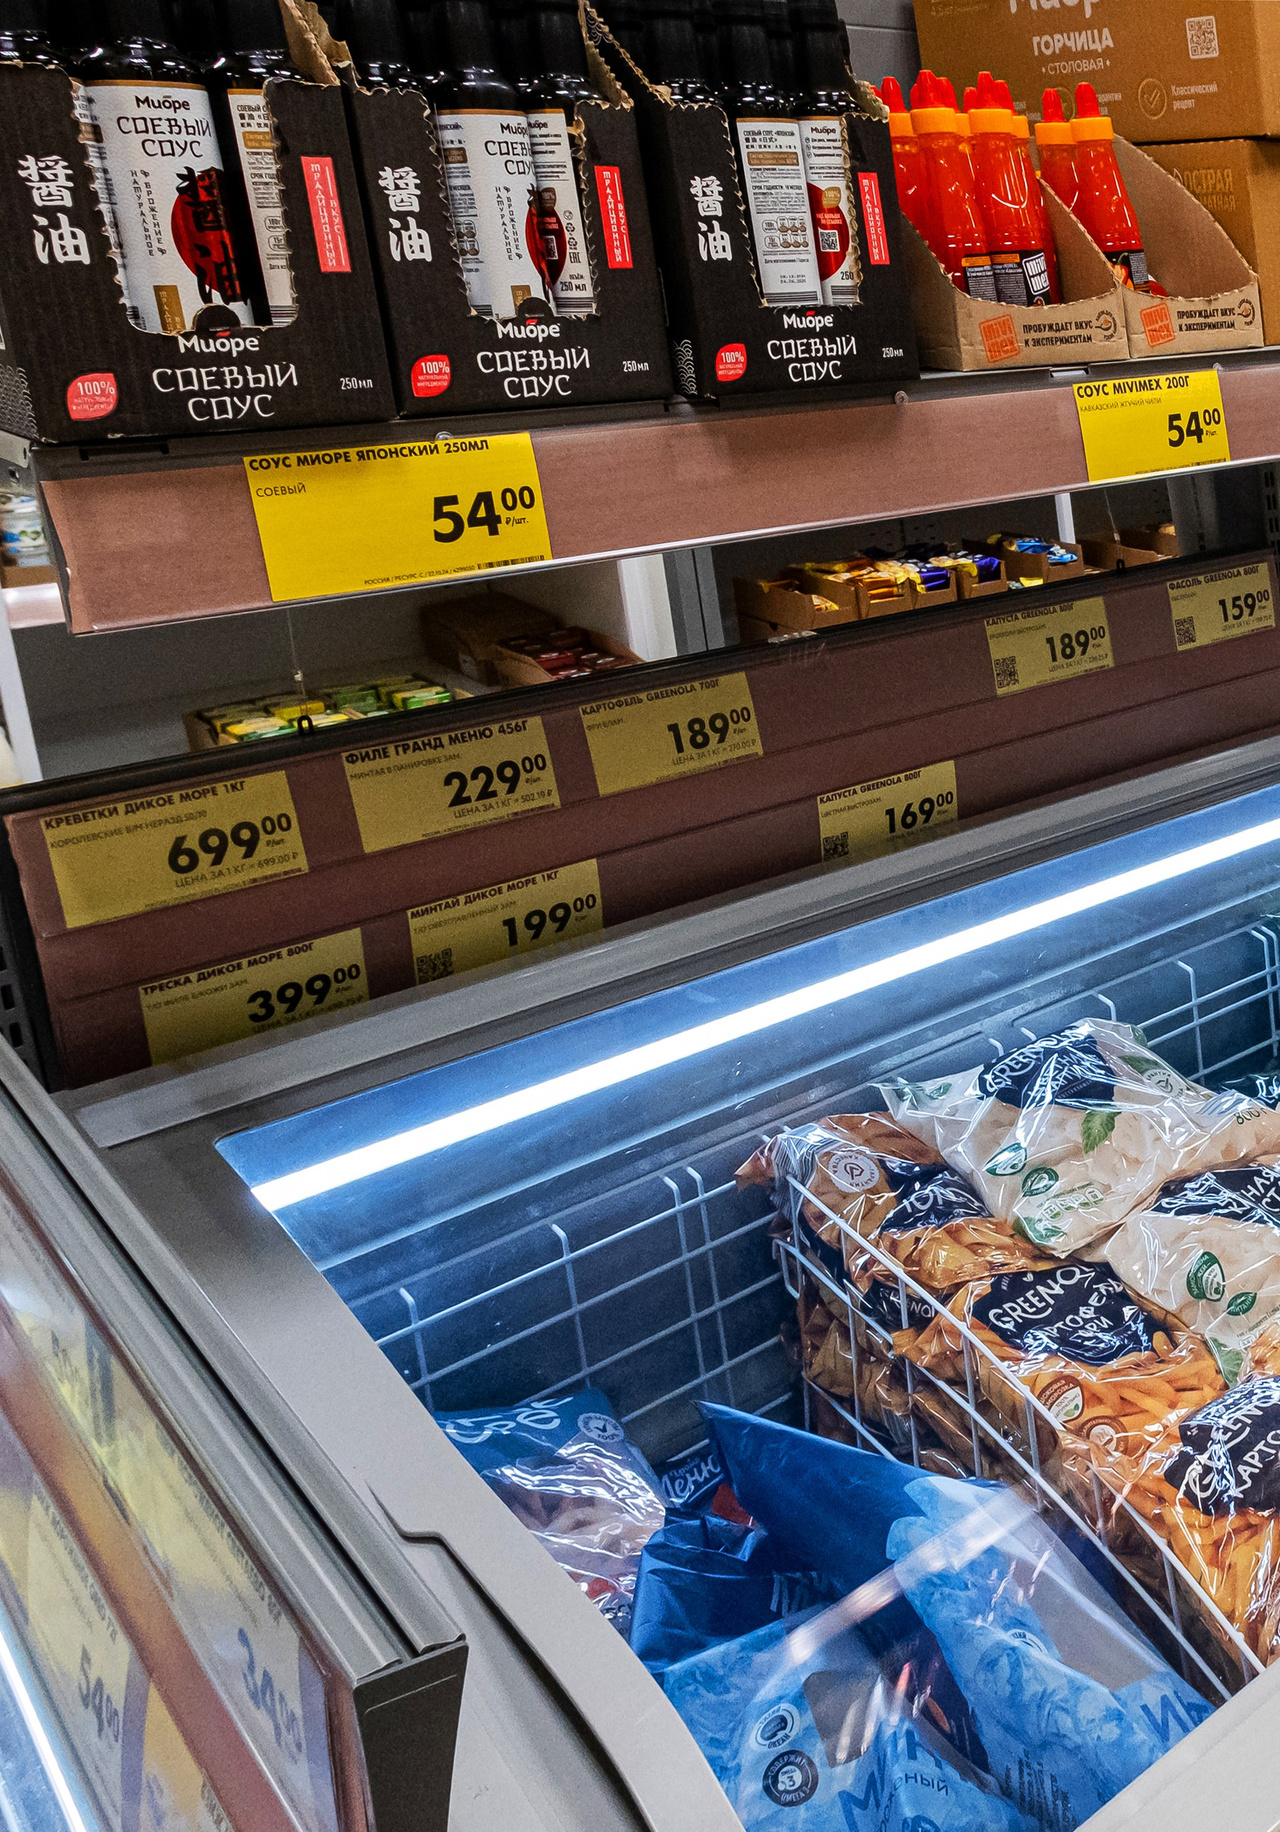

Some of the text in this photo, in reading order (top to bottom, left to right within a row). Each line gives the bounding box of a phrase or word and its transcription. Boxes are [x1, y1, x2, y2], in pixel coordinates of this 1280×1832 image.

[1033, 28, 1114, 56] ГОРЧИЦА
[1047, 58, 1105, 75] СТОЛОВАЯ
[1171, 82, 1217, 95] Классический
[1173, 99, 1195, 111] рецепт
[116, 116, 212, 138] СОЕВЫЙ
[141, 138, 203, 158] СОУС
[1183, 169, 1233, 191] ОСТРАЯ
[130, 169, 155, 257] НАТУРАЛЬНОЕ
[144, 182, 163, 245] БРОЖЕНИЕ
[310, 163, 337, 267] ТРАДИЦИОННЫЙ
[329, 199, 342, 234] ВКУС
[602, 171, 623, 263] ТРАДИЦИОННЫЙ
[617, 202, 627, 234] ВКУС
[861, 178, 880, 261] ТРАДИЦИОННЫЙ
[874, 206, 883, 235] ВКУС
[1176, 307, 1236, 320] ПРОБУЖДАЕТ ВКУС
[1178, 319, 1235, 331] К ЭКСПЕРИМЕНТАМ
[1023, 319, 1093, 335] ПРОБУЖДАЕТ ВКУС
[767, 334, 857, 360] СОЕВЫЙ
[1024, 333, 1092, 347] К ЭКСПЕРИМЕНТАМ
[420, 361, 450, 374] 100%
[477, 346, 591, 371] СОЕВЫЙ
[720, 350, 745, 364] 100%
[152, 362, 299, 392] СОЕВЫЙ
[788, 360, 843, 383] СОУС
[76, 381, 116, 396] 100%
[503, 375, 572, 398] СОУС
[1077, 375, 1189, 399] СОУС MIVIMEX 200Г
[187, 394, 275, 421] СОУС
[1080, 397, 1162, 413] КАВКАЗСКИЙ ЖГУЧИЙ ЧИЛИ
[249, 439, 489, 471] СОУС МИОРЕ ЯПОНСКИЙ 250МЛ
[255, 482, 307, 498] СОЕВЫЙ
[1168, 577, 1202, 591] ФАСОЛЬ
[1204, 569, 1242, 584] GREENOLA
[986, 613, 1019, 627] КАПУСТА
[1021, 607, 1057, 620] GREENOLA
[581, 678, 719, 717] КАРТОФЕЛЬ GREENOLA 700Г
[345, 719, 529, 765] ФИЛЕ ГРАНД МЕНЮ 456Г
[819, 787, 858, 805] КАПУСТА
[860, 776, 902, 794] GREENOLA
[44, 780, 247, 830] КРЕВЕТКИ ДИКОЕ МОРЕ 1КГ
[454, 806, 481, 819] ЦЕНА
[482, 802, 494, 812] ЗА
[175, 874, 209, 889] ЦЕНА
[210, 868, 226, 880] ЗА
[234, 863, 247, 876] КГ
[410, 870, 559, 919] МИНТАЙ ДИКОЕ МОРЕ 1КГ
[141, 942, 315, 996] ТРЕСКА ДИКОЕ МОРЕ 800Г
